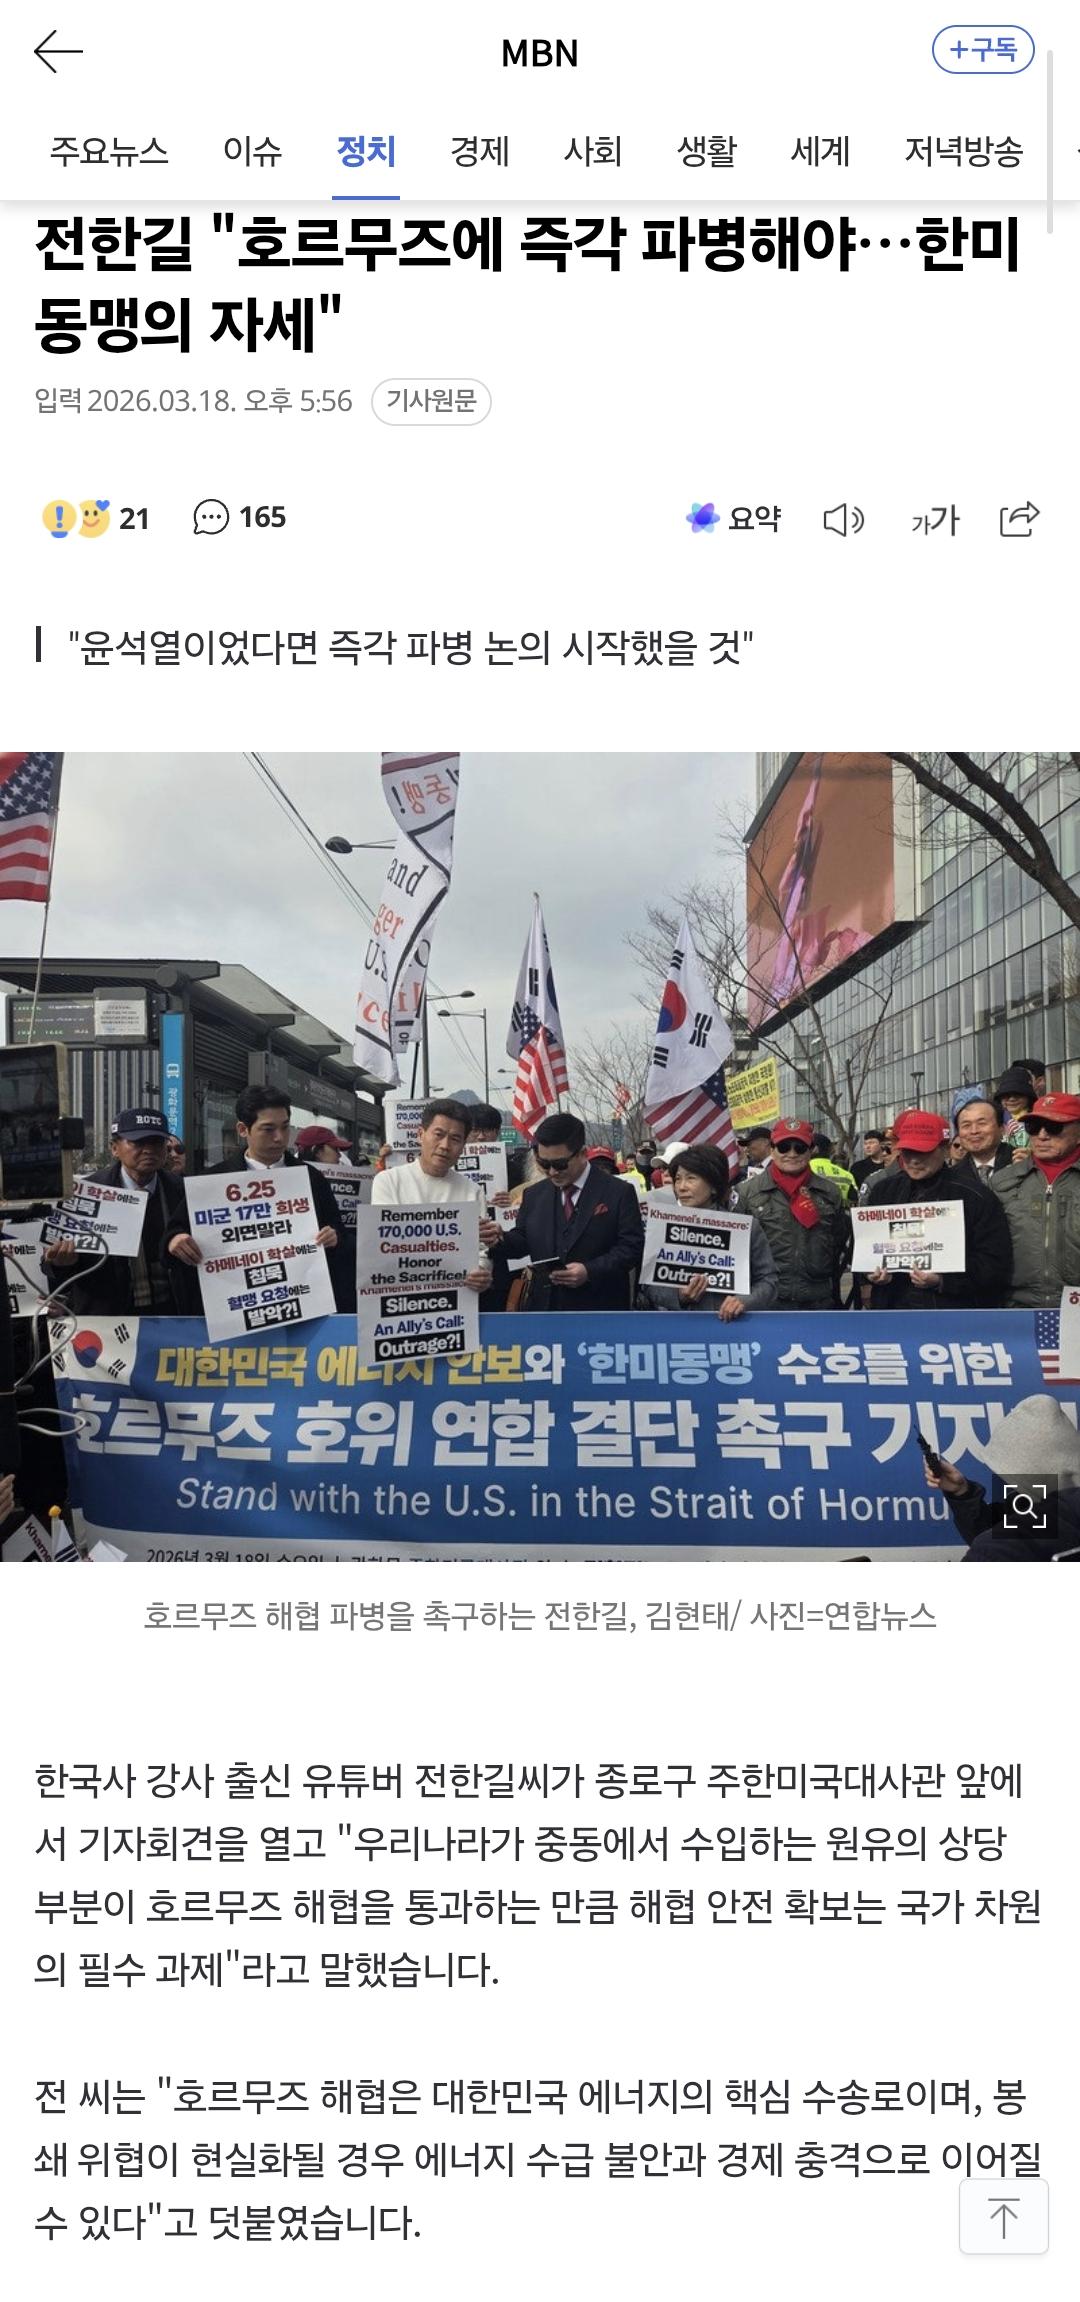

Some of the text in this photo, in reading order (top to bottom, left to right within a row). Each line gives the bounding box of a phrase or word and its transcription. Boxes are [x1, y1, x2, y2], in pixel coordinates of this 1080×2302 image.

[387, 858, 428, 897] and
[88, 1187, 140, 1205] 학살에는
[226, 1180, 276, 1202] 6.25
[194, 1198, 310, 1226] 미군 17만 희생
[381, 1208, 460, 1222] Remember
[650, 1208, 700, 1223] Khamenei's
[702, 1218, 750, 1231] massacre:
[857, 1207, 907, 1222] 하메네이
[222, 1219, 292, 1243] 외면말라
[378, 1223, 462, 1239] 170,000 U.S.
[669, 1226, 725, 1248] Silence.
[380, 1240, 460, 1254] Casualties.
[657, 1248, 735, 1267] An Ally's Call:
[899, 1241, 944, 1253] 요청에는
[204, 1244, 317, 1274] 하메네이 학살에는
[398, 1257, 442, 1268] Honor
[248, 1264, 283, 1286] 침묵
[371, 1270, 467, 1285] the Sacrifice!
[227, 1284, 311, 1311] 혈맹 요청에는
[386, 1297, 452, 1313] Silence.
[248, 1301, 299, 1327] 발악?!
[374, 1315, 464, 1336] An Ally's Call:
[379, 1333, 461, 1357] Outrage?!
[155, 1346, 306, 1387] 대한민국
[447, 1343, 565, 1385] 안보와
[778, 1342, 908, 1386] 수호를
[918, 1342, 1013, 1386] 위한
[72, 1393, 275, 1462] 호르무즈
[287, 1400, 414, 1467] 호위
[432, 1399, 555, 1467] 연합
[570, 1399, 700, 1468] 결단
[716, 1398, 852, 1470] 촉구
[176, 1477, 278, 1513] Stand
[289, 1483, 360, 1515] with
[374, 1484, 430, 1516] the
[445, 1484, 516, 1517] U.S.
[531, 1484, 562, 1518] in
[576, 1486, 636, 1519] the
[650, 1486, 753, 1520] Strait
[768, 1487, 804, 1520] of
